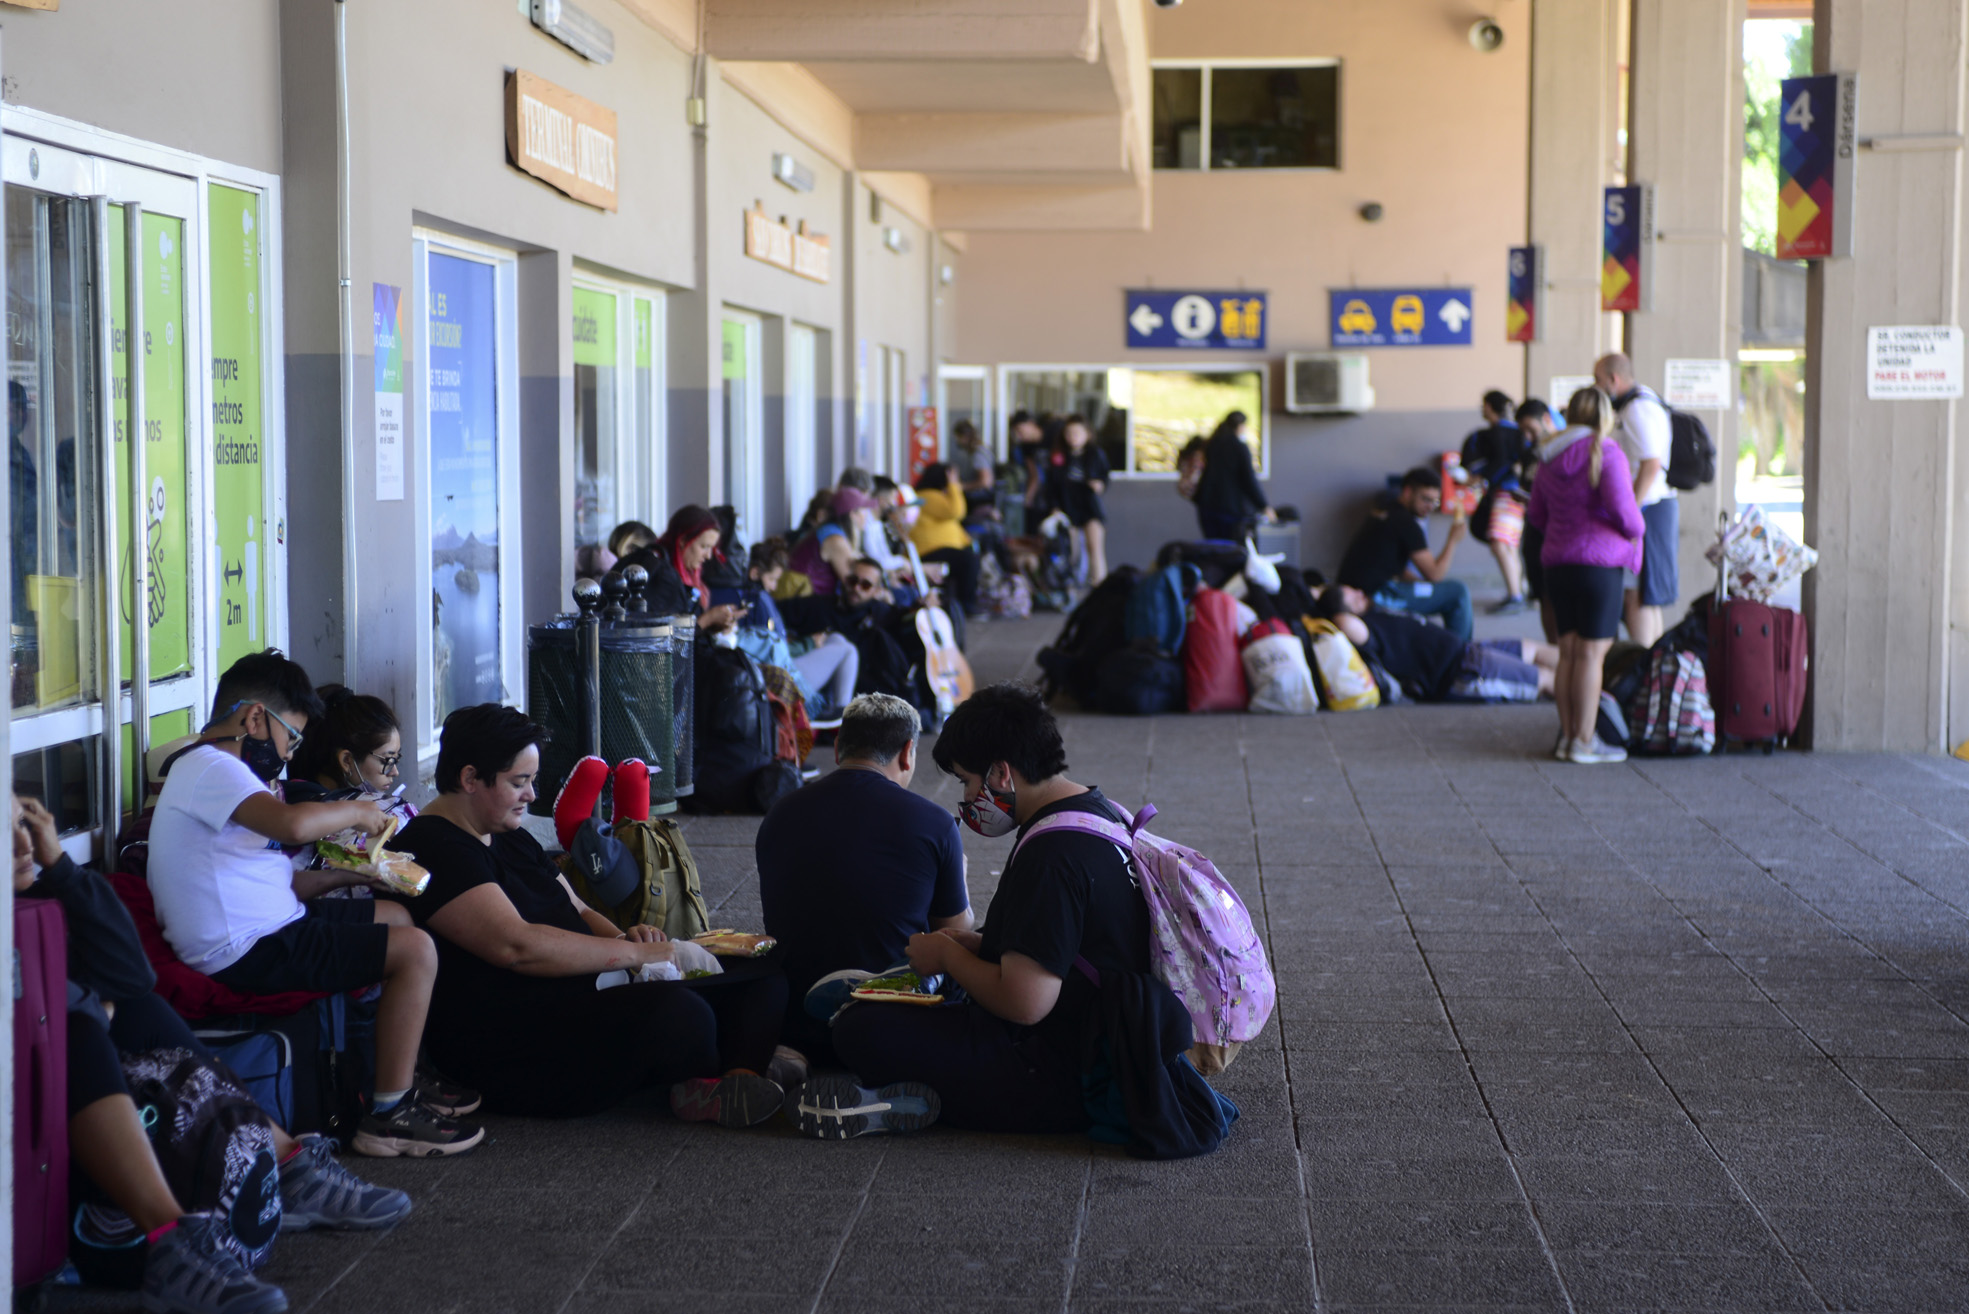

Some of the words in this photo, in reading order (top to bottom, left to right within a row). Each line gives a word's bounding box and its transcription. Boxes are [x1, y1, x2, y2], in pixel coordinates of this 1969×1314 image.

[1785, 89, 1815, 132] 4
[522, 93, 575, 174] TERMINAL
[1606, 193, 1626, 226] 5
[216, 434, 258, 465] distancia
